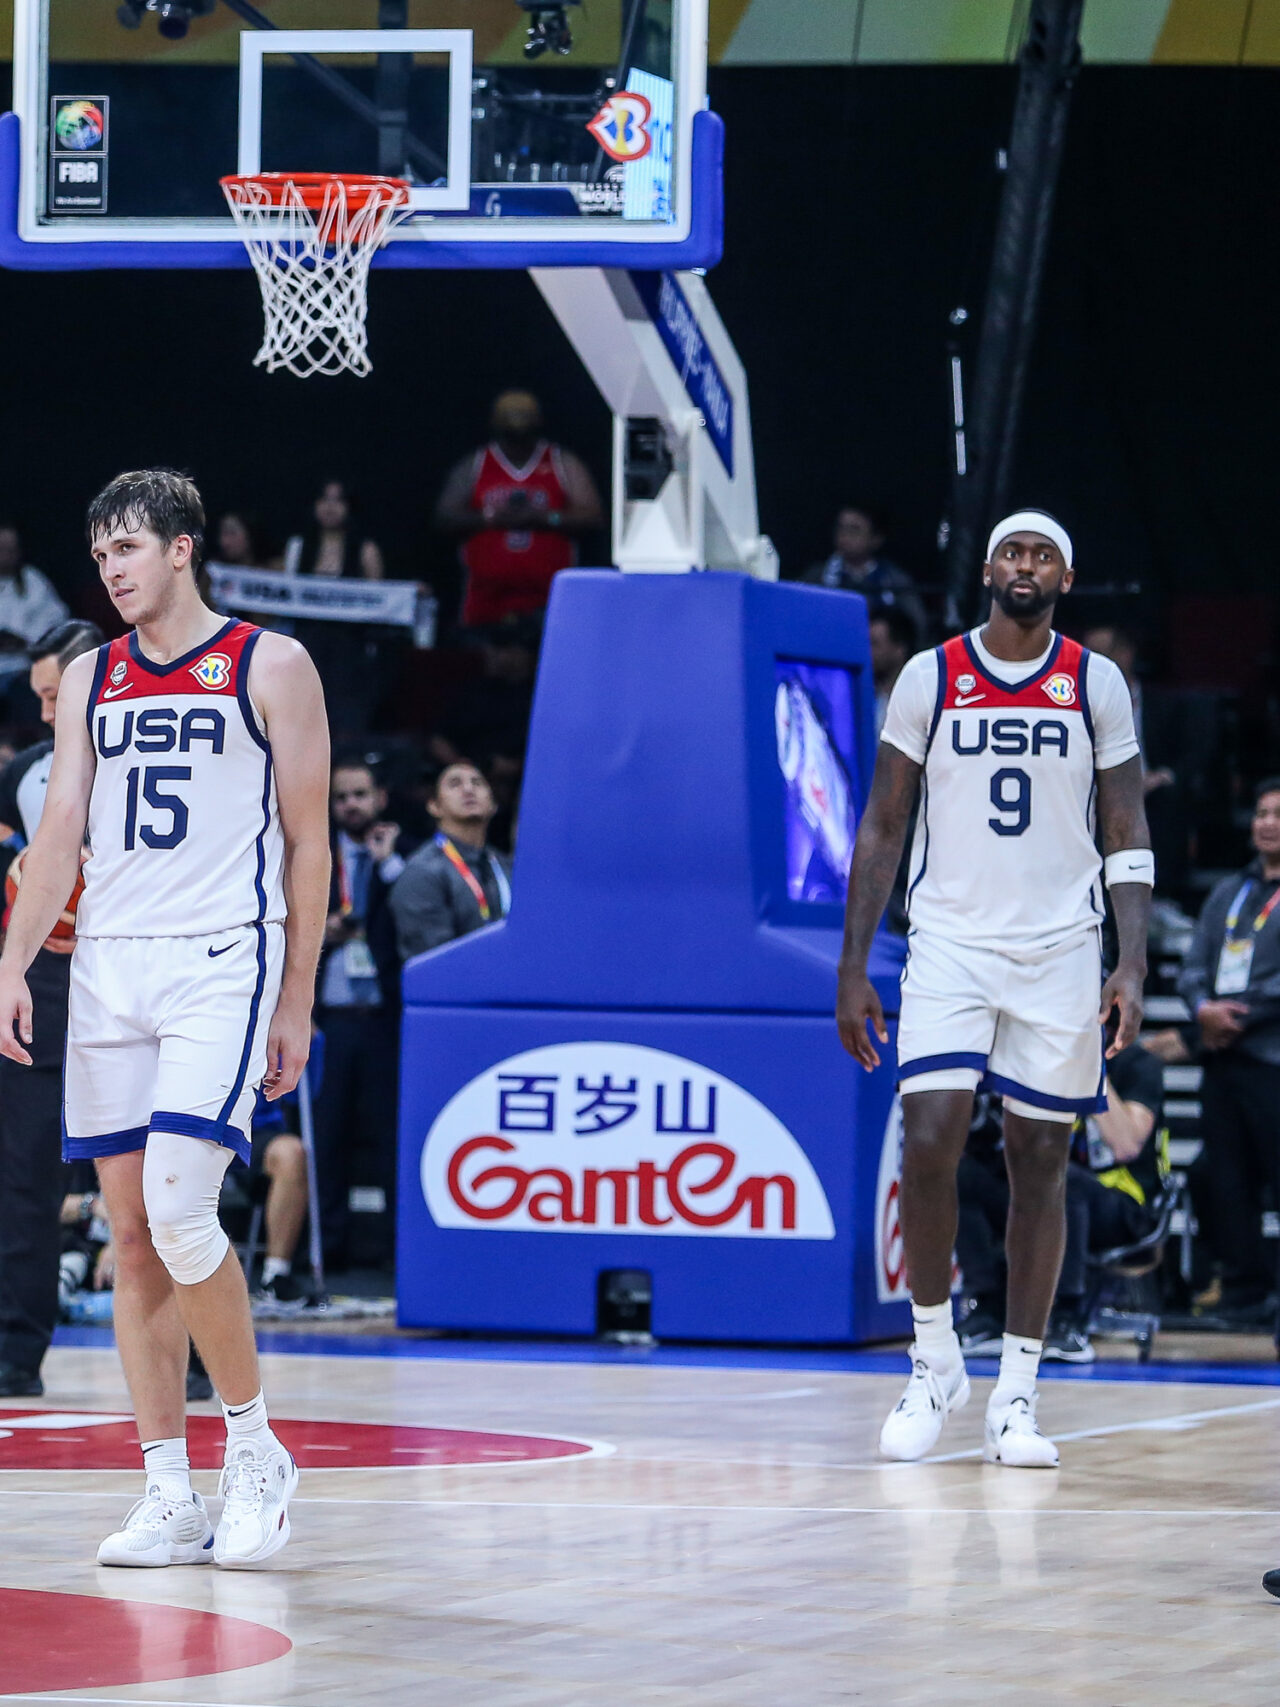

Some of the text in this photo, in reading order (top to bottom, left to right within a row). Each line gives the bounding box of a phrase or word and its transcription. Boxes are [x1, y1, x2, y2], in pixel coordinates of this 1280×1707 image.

[58, 161, 98, 183] FIBA
[98, 708, 226, 759] USA
[952, 718, 1068, 758] USA
[124, 766, 192, 851] 15
[988, 768, 1031, 836] 9
[497, 1074, 716, 1136] 百岁山
